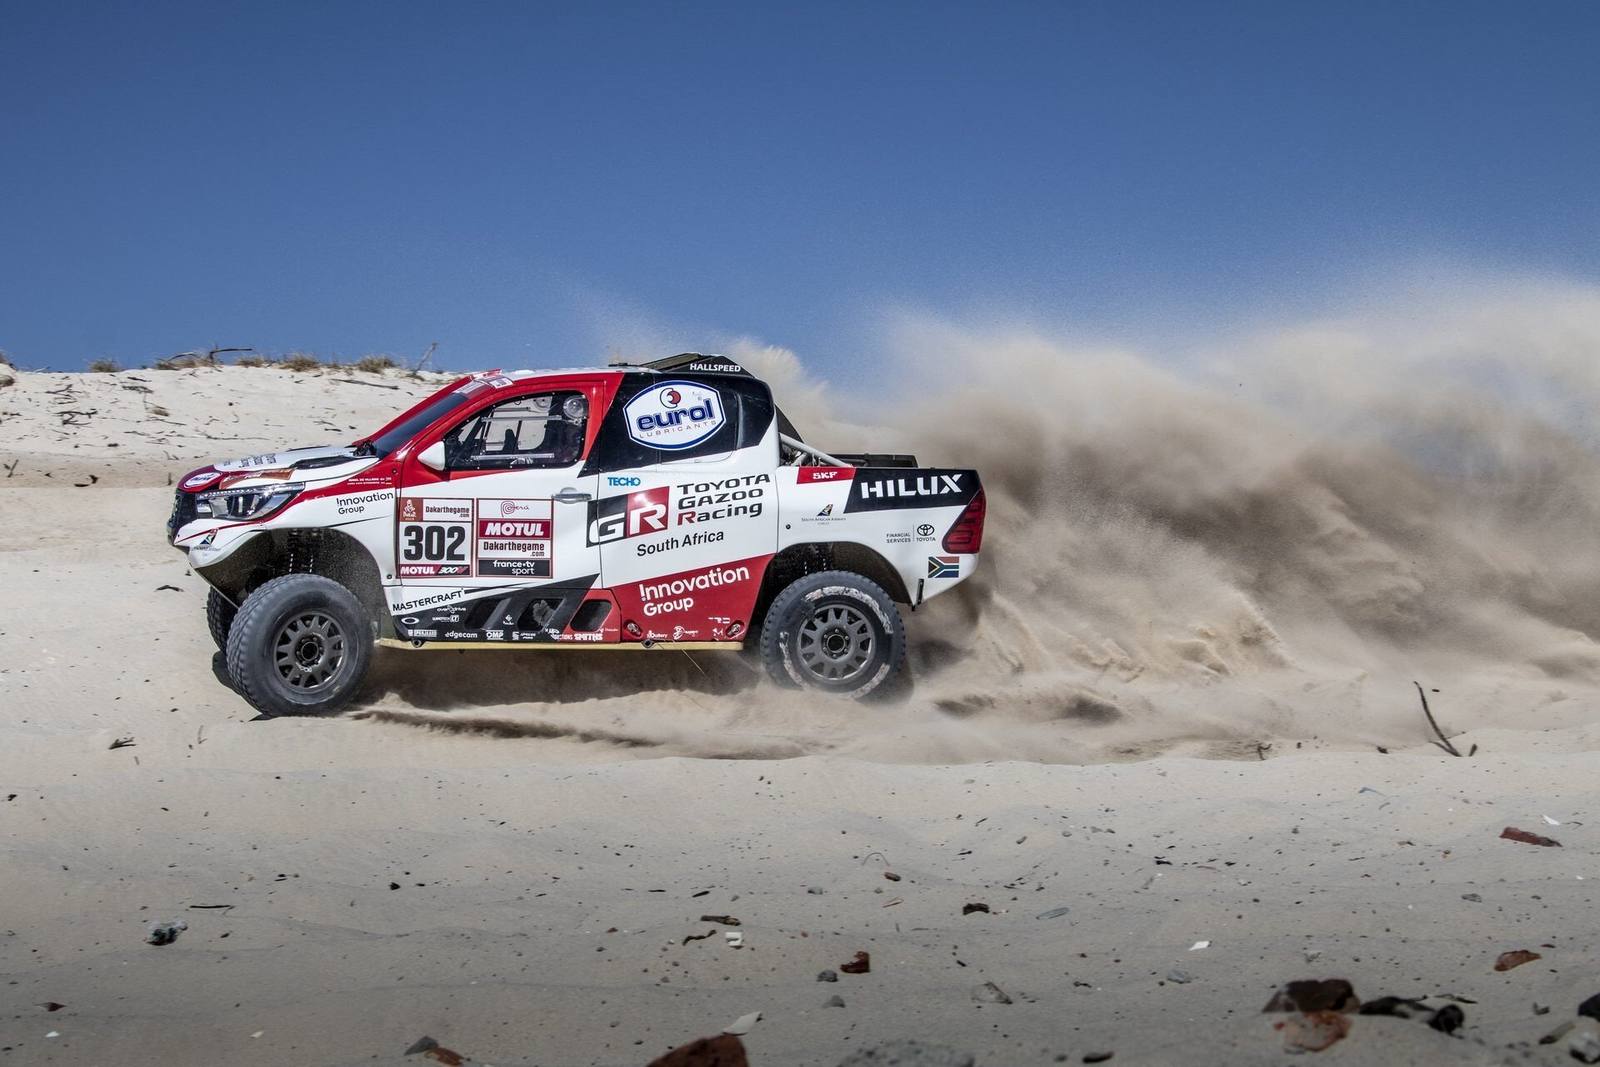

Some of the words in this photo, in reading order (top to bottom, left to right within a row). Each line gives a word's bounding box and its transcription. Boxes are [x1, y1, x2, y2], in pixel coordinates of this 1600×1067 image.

[689, 363, 741, 372] HALLSPEED
[636, 398, 716, 432] eurol
[639, 420, 717, 439] LUBRICANTS
[607, 477, 641, 487] TECHO
[677, 473, 771, 495] TOYOTA
[812, 471, 838, 480] SKF
[861, 473, 963, 499] HILUX
[678, 488, 764, 510] GAZOO
[338, 505, 365, 515] Group
[425, 506, 470, 514] Dakarthegame
[677, 502, 763, 526] Racing
[484, 523, 544, 536] MOTUL
[588, 502, 668, 544] GR
[403, 525, 466, 561] 302
[483, 541, 545, 552] Dakarthegame
[637, 537, 679, 557] South
[682, 530, 724, 548] Africa
[400, 566, 436, 575] MOTUL
[511, 567, 535, 576] sport
[392, 590, 462, 612] MASTERCRAFT
[643, 597, 694, 616] Group
[445, 630, 478, 639] edgecam
